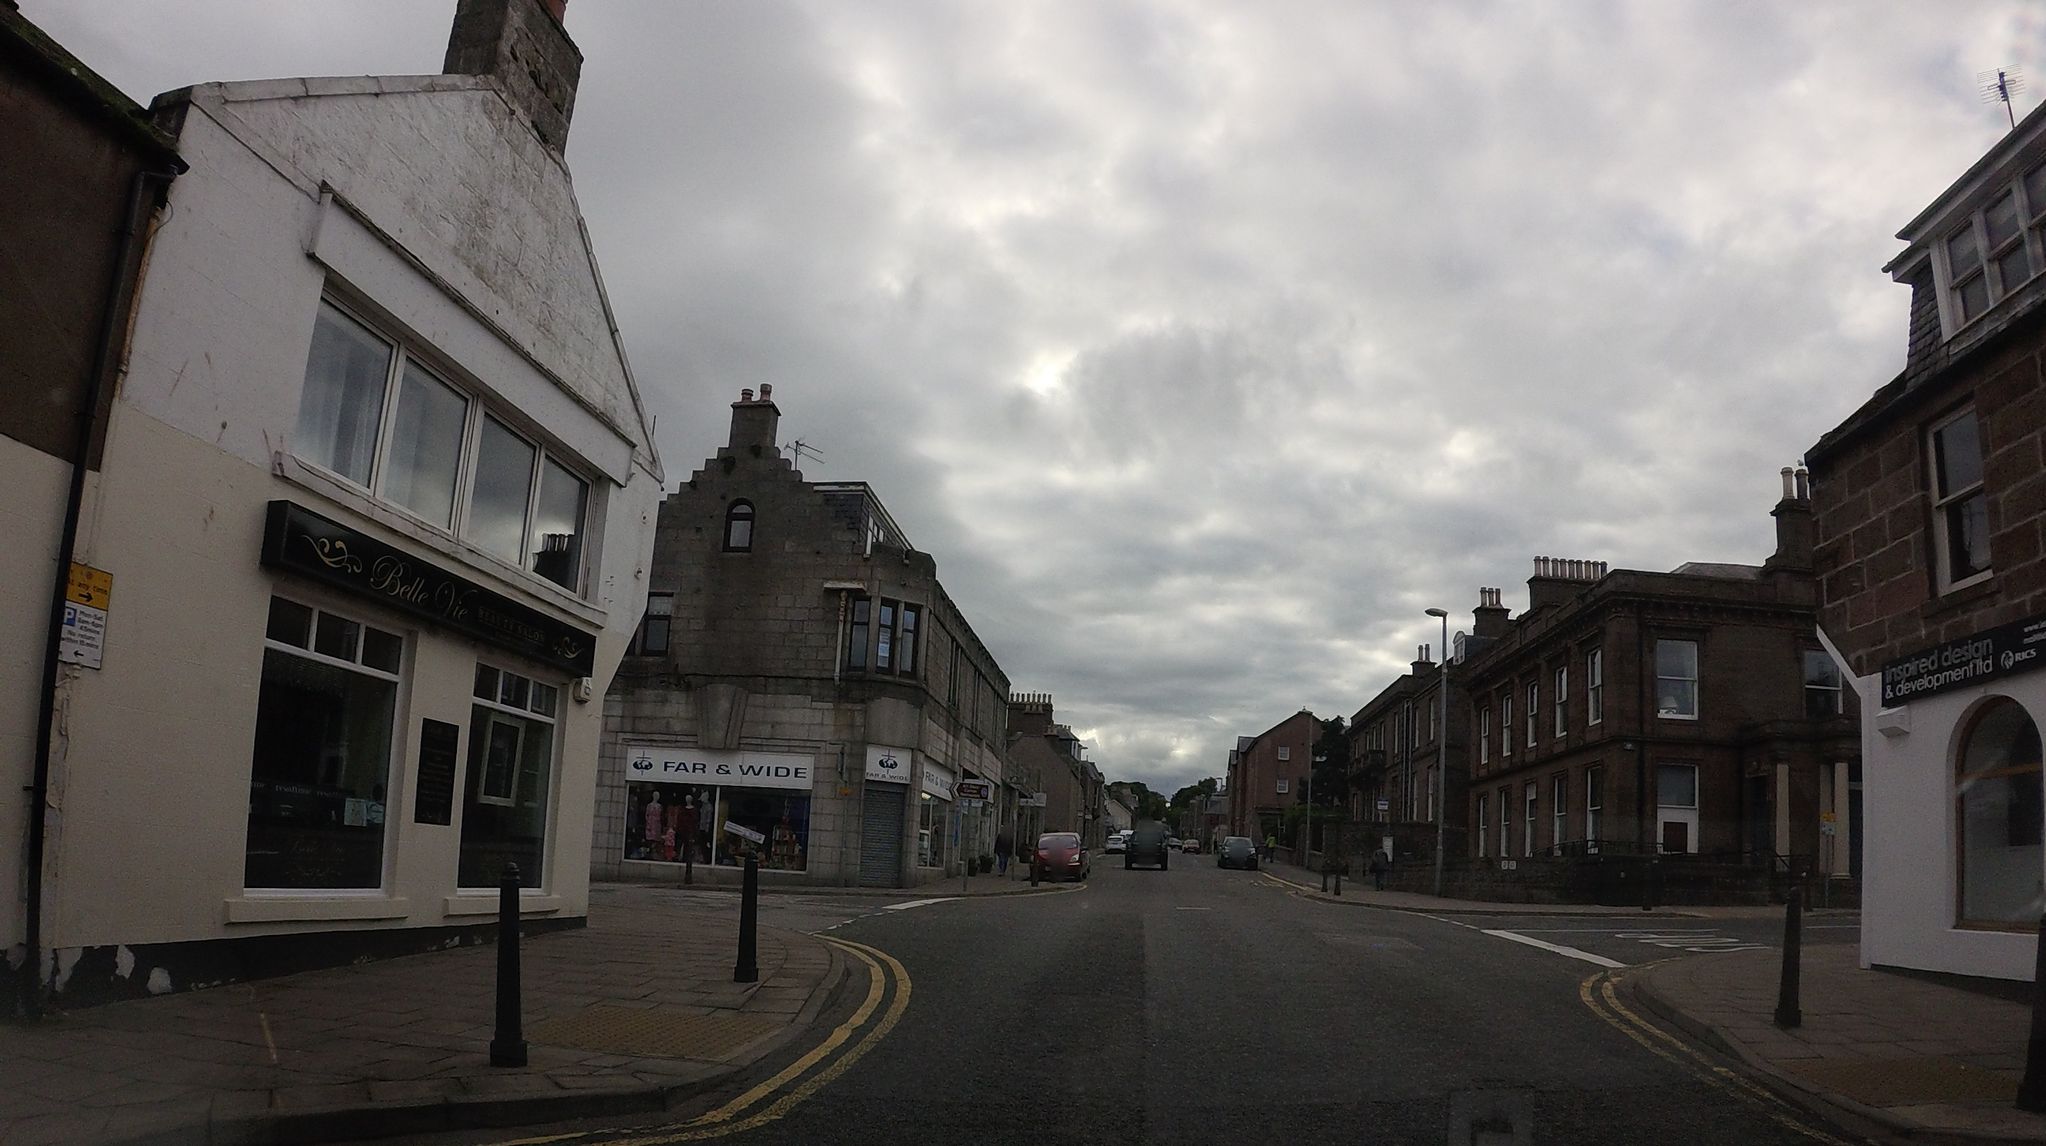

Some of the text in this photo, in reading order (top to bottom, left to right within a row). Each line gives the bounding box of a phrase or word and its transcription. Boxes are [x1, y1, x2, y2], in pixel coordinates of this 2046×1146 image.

[369, 555, 477, 619] Belle Vie
[1885, 638, 1992, 683] inspired design
[2015, 648, 2037, 662] RICS
[1885, 684, 1894, 699] &
[1896, 660, 1974, 696] development
[663, 761, 808, 779] FAR & WIDE
